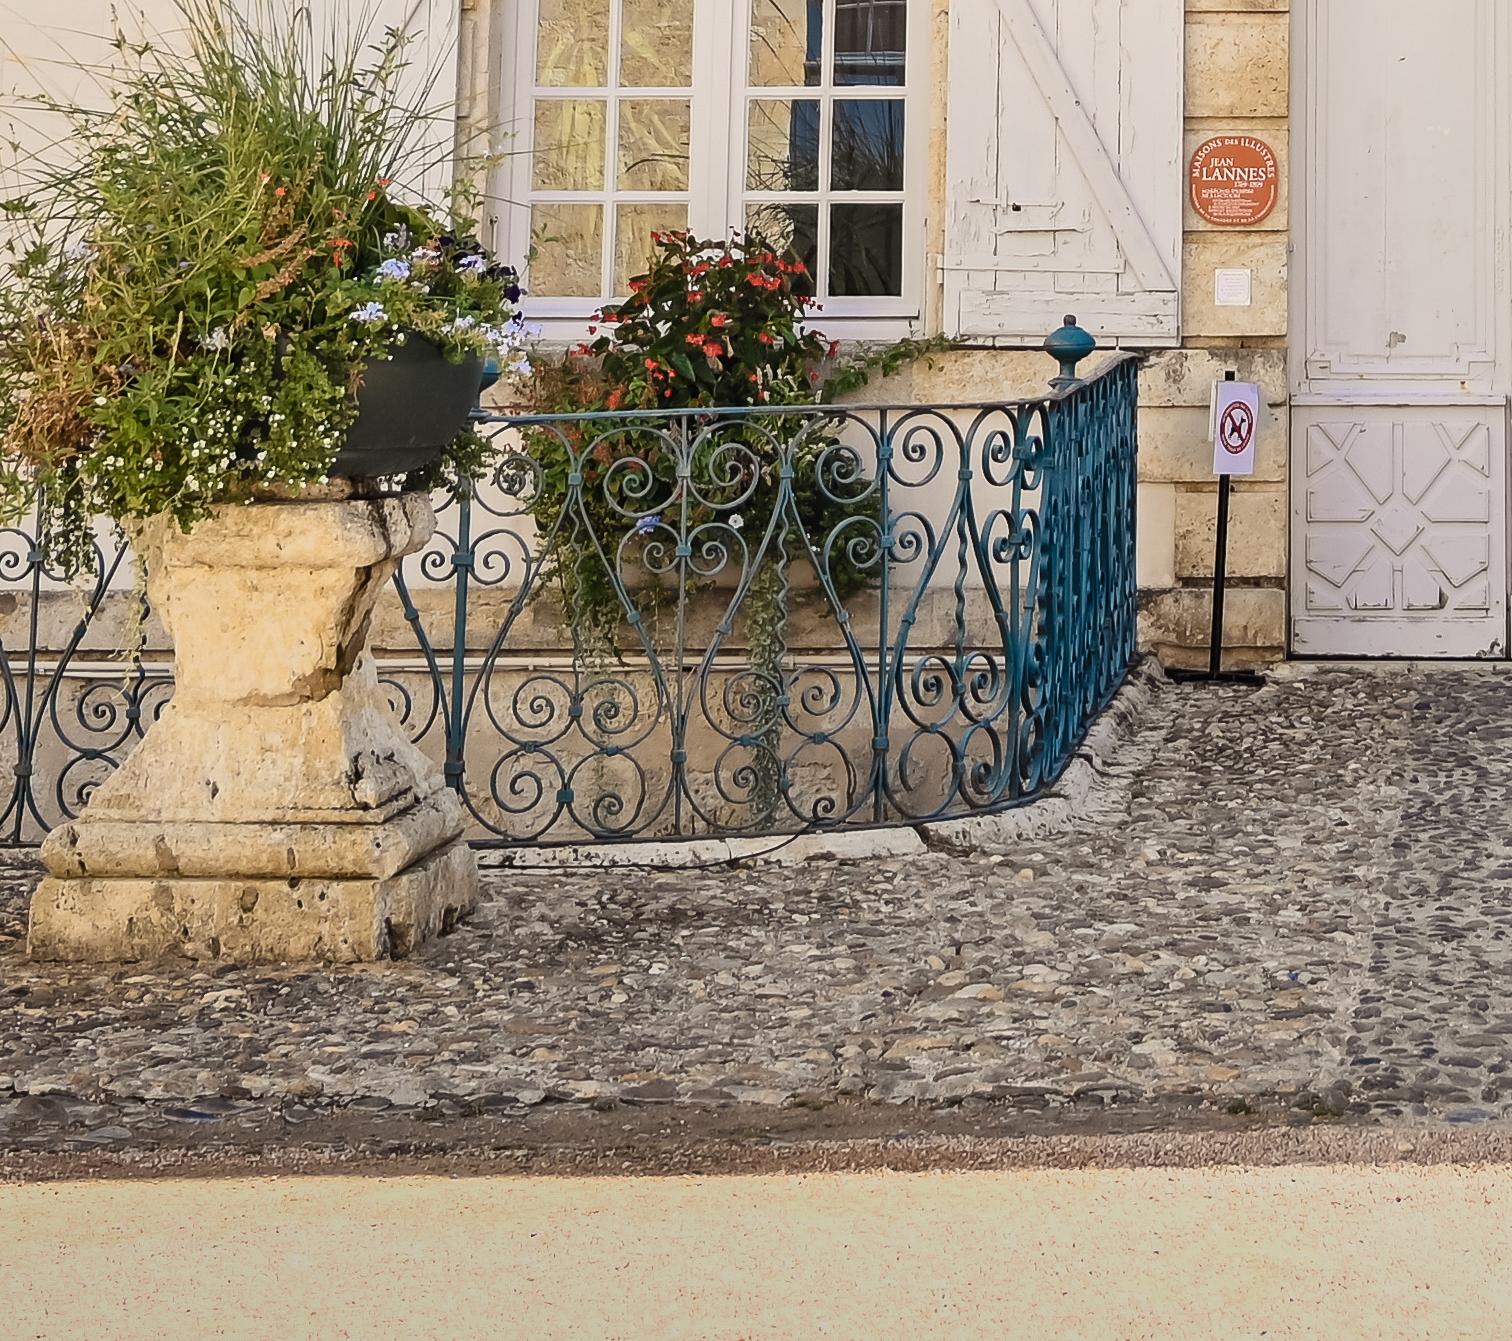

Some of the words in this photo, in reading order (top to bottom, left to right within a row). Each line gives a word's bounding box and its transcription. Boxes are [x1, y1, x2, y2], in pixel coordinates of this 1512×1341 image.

[1192, 139, 1222, 177] MAISONS
[1241, 138, 1275, 178] ILLUSTRES
[1210, 157, 1234, 168] JEAN
[1202, 167, 1266, 181] LANNES
